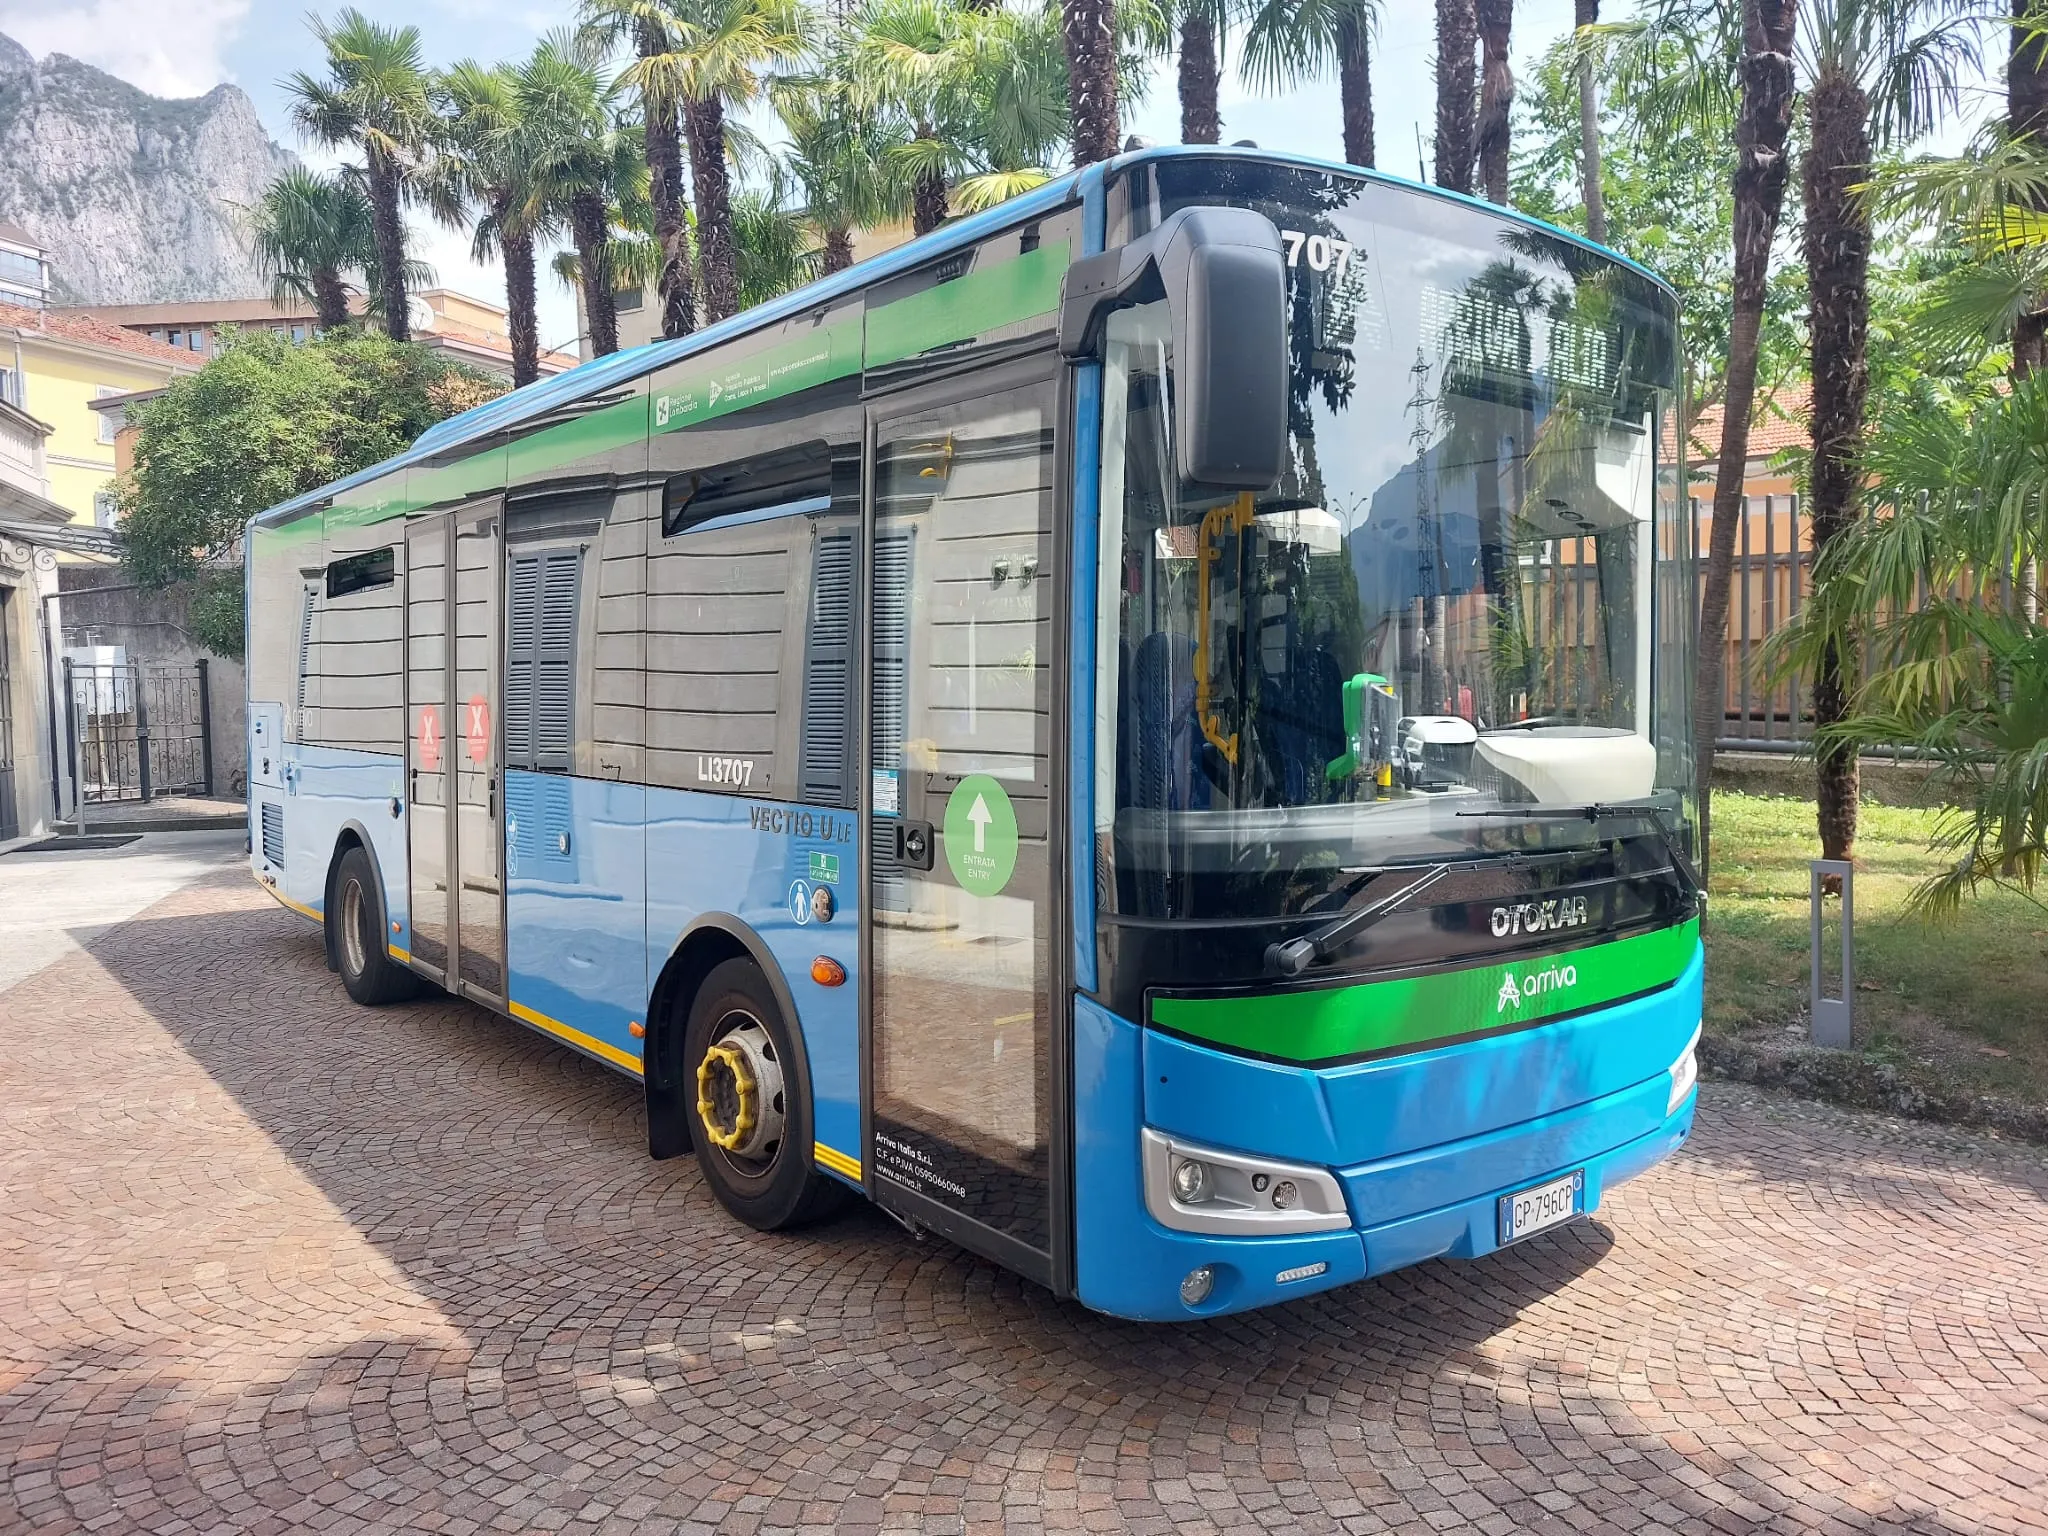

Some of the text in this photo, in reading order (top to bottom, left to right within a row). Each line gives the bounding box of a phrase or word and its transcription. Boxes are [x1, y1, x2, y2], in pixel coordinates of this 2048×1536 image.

[698, 756, 754, 787] LI3707
[750, 805, 852, 843] VECTIO U LE
[963, 854, 996, 869] ENTRATA
[967, 868, 991, 881] ENTRY
[1490, 895, 1588, 937] OTOKAR
[1523, 964, 1577, 997] arriva
[875, 1131, 897, 1150] Arriva
[897, 1141, 917, 1159] Italia
[876, 1147, 967, 1199] C.F. e P.IVA 05950660968
[876, 1163, 922, 1192] www.arriva.it
